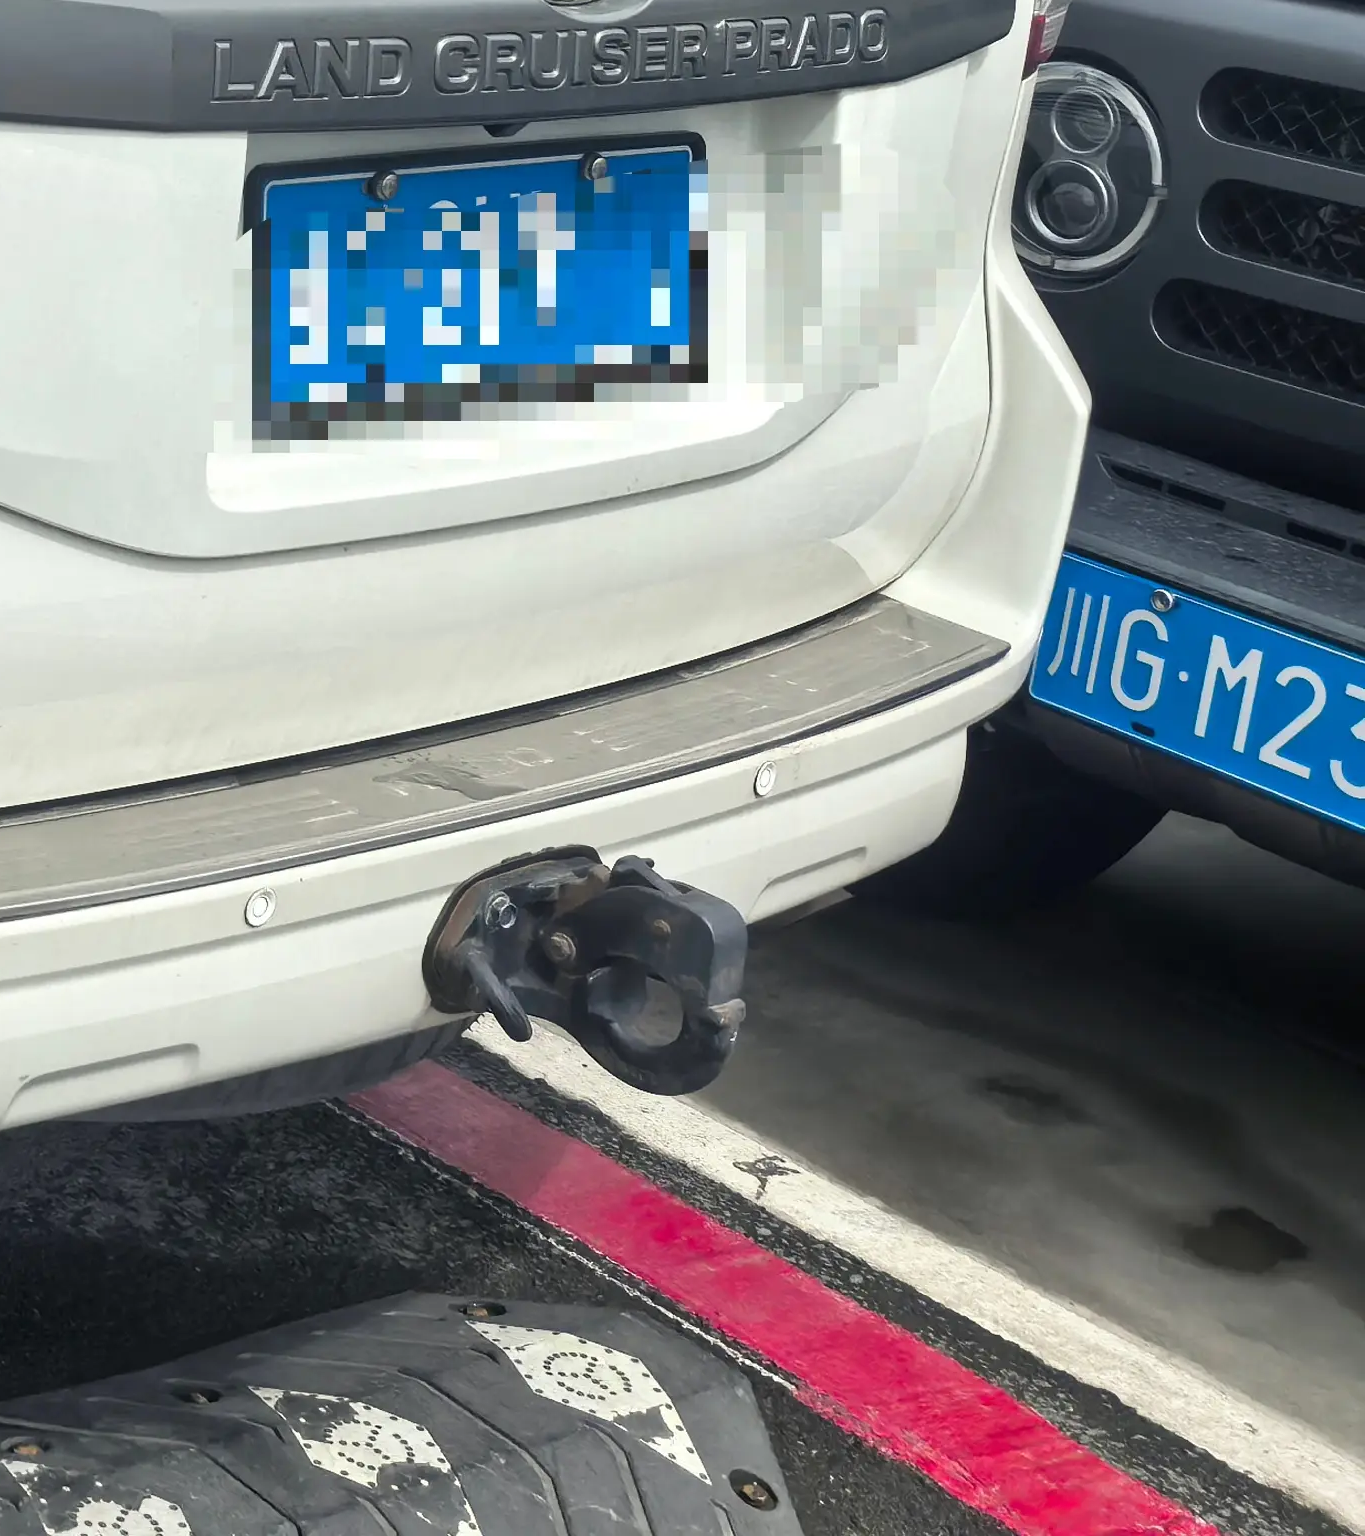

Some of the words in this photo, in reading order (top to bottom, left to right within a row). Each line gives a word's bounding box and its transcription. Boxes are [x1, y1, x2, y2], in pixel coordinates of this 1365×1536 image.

[210, 35, 413, 104] LAND
[432, 22, 707, 96] CRUISER
[719, 7, 891, 77] PRADO
